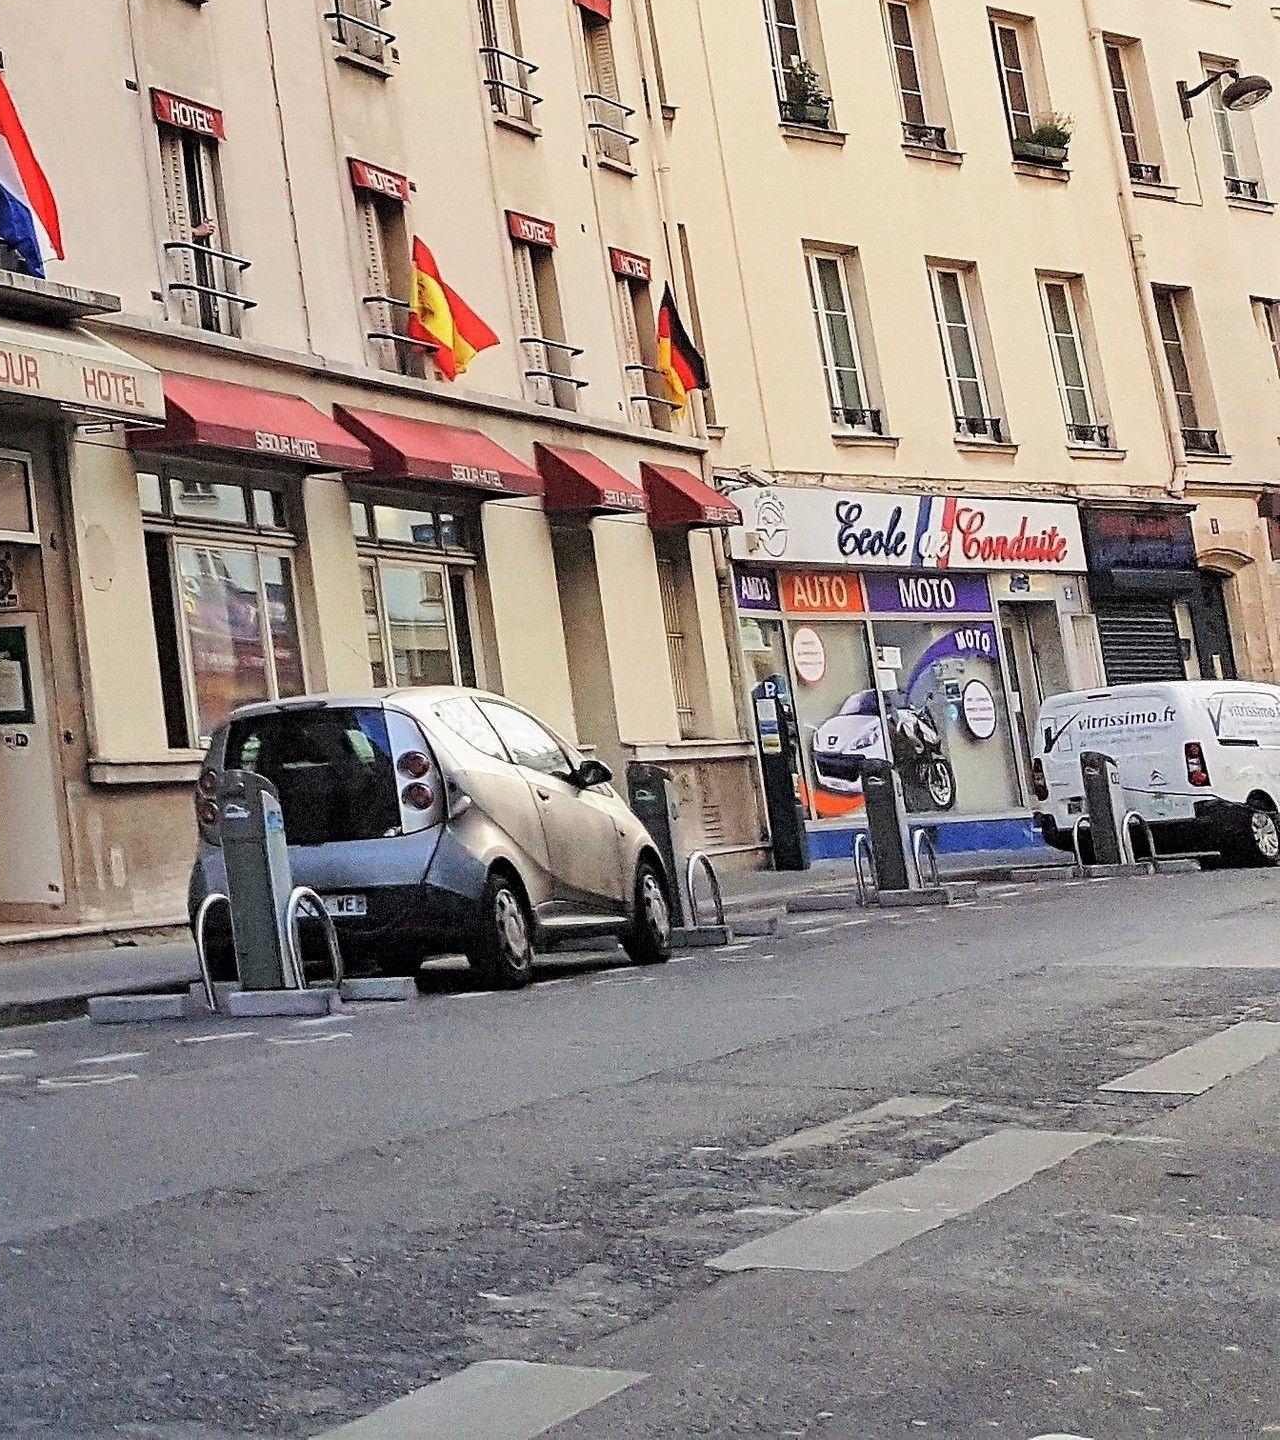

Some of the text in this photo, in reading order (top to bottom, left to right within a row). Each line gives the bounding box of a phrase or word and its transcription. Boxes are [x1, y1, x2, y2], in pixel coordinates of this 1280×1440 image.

[169, 98, 214, 133] HOTEL
[83, 366, 145, 409] HOTEL
[292, 438, 321, 459] HOTEL
[836, 500, 907, 557] Ecole
[957, 508, 1068, 563] Conduite
[793, 577, 848, 608] AUTO
[898, 578, 955, 609] MOTO
[955, 629, 990, 654] MOTO
[1078, 706, 1176, 731] vitrissimo.fr
